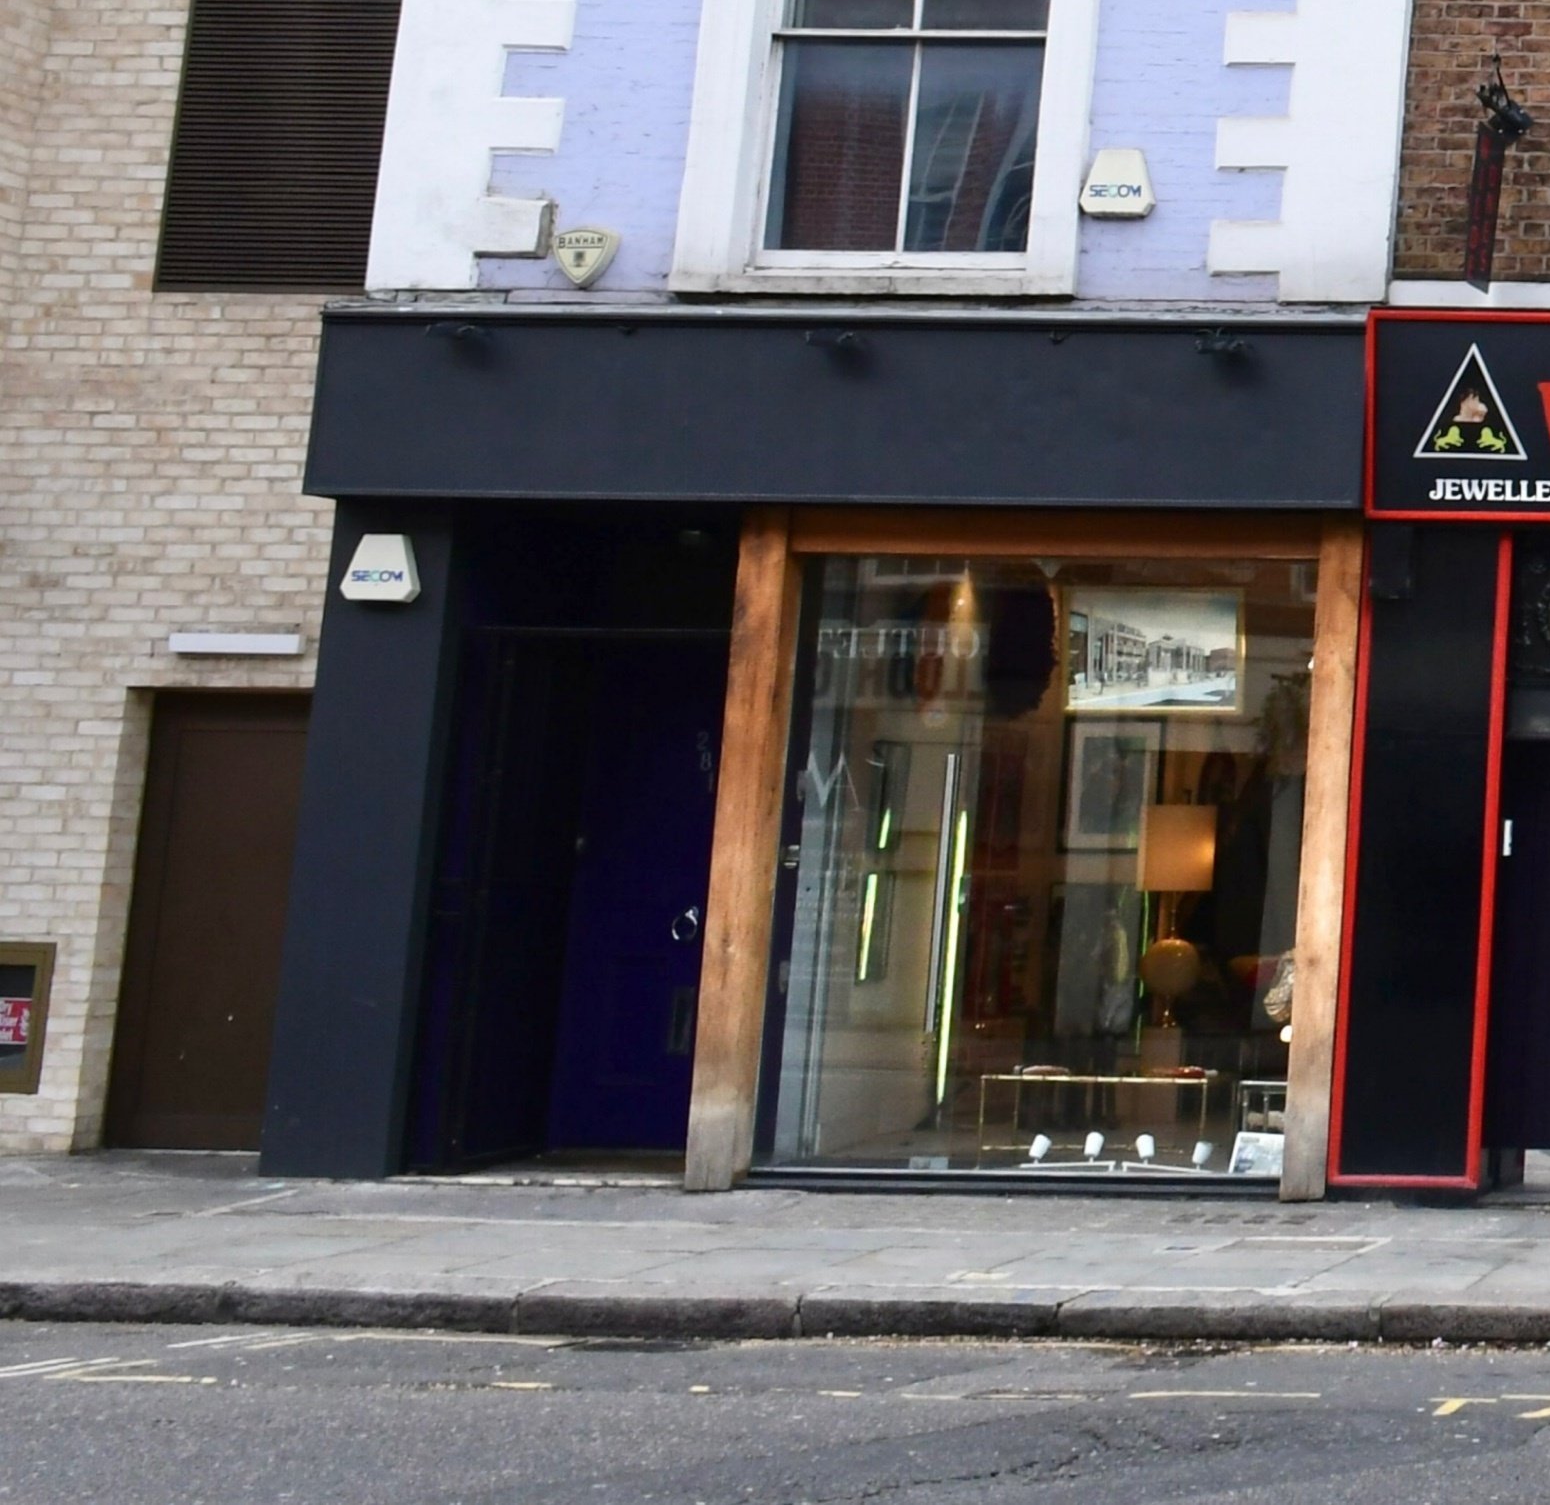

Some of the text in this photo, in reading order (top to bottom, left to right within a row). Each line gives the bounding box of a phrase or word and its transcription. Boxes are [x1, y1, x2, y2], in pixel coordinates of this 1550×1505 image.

[1088, 184, 1142, 198] SECOM
[558, 235, 606, 249] BANHAM
[350, 570, 404, 582] SECOM
